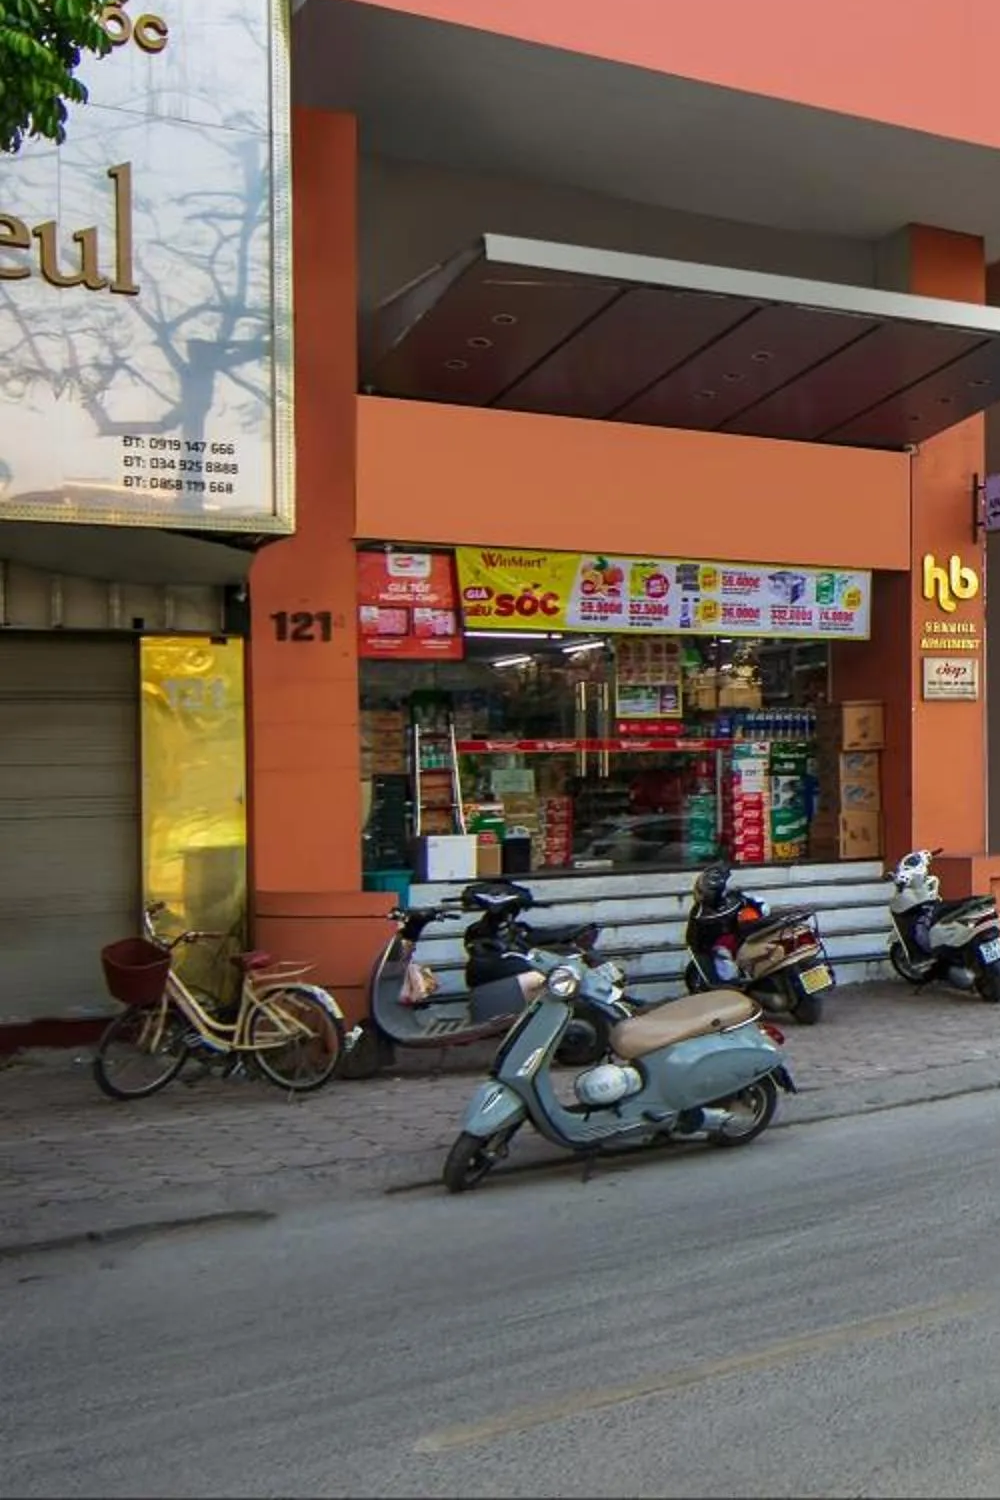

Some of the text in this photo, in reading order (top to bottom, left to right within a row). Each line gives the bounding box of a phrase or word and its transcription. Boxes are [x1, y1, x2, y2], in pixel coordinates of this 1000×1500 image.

[149, 437, 181, 452] 0919
[184, 441, 206, 453] 147
[149, 457, 176, 470] 034
[923, 553, 979, 612] hb
[494, 583, 560, 617] SỐC
[270, 611, 332, 642] 121
